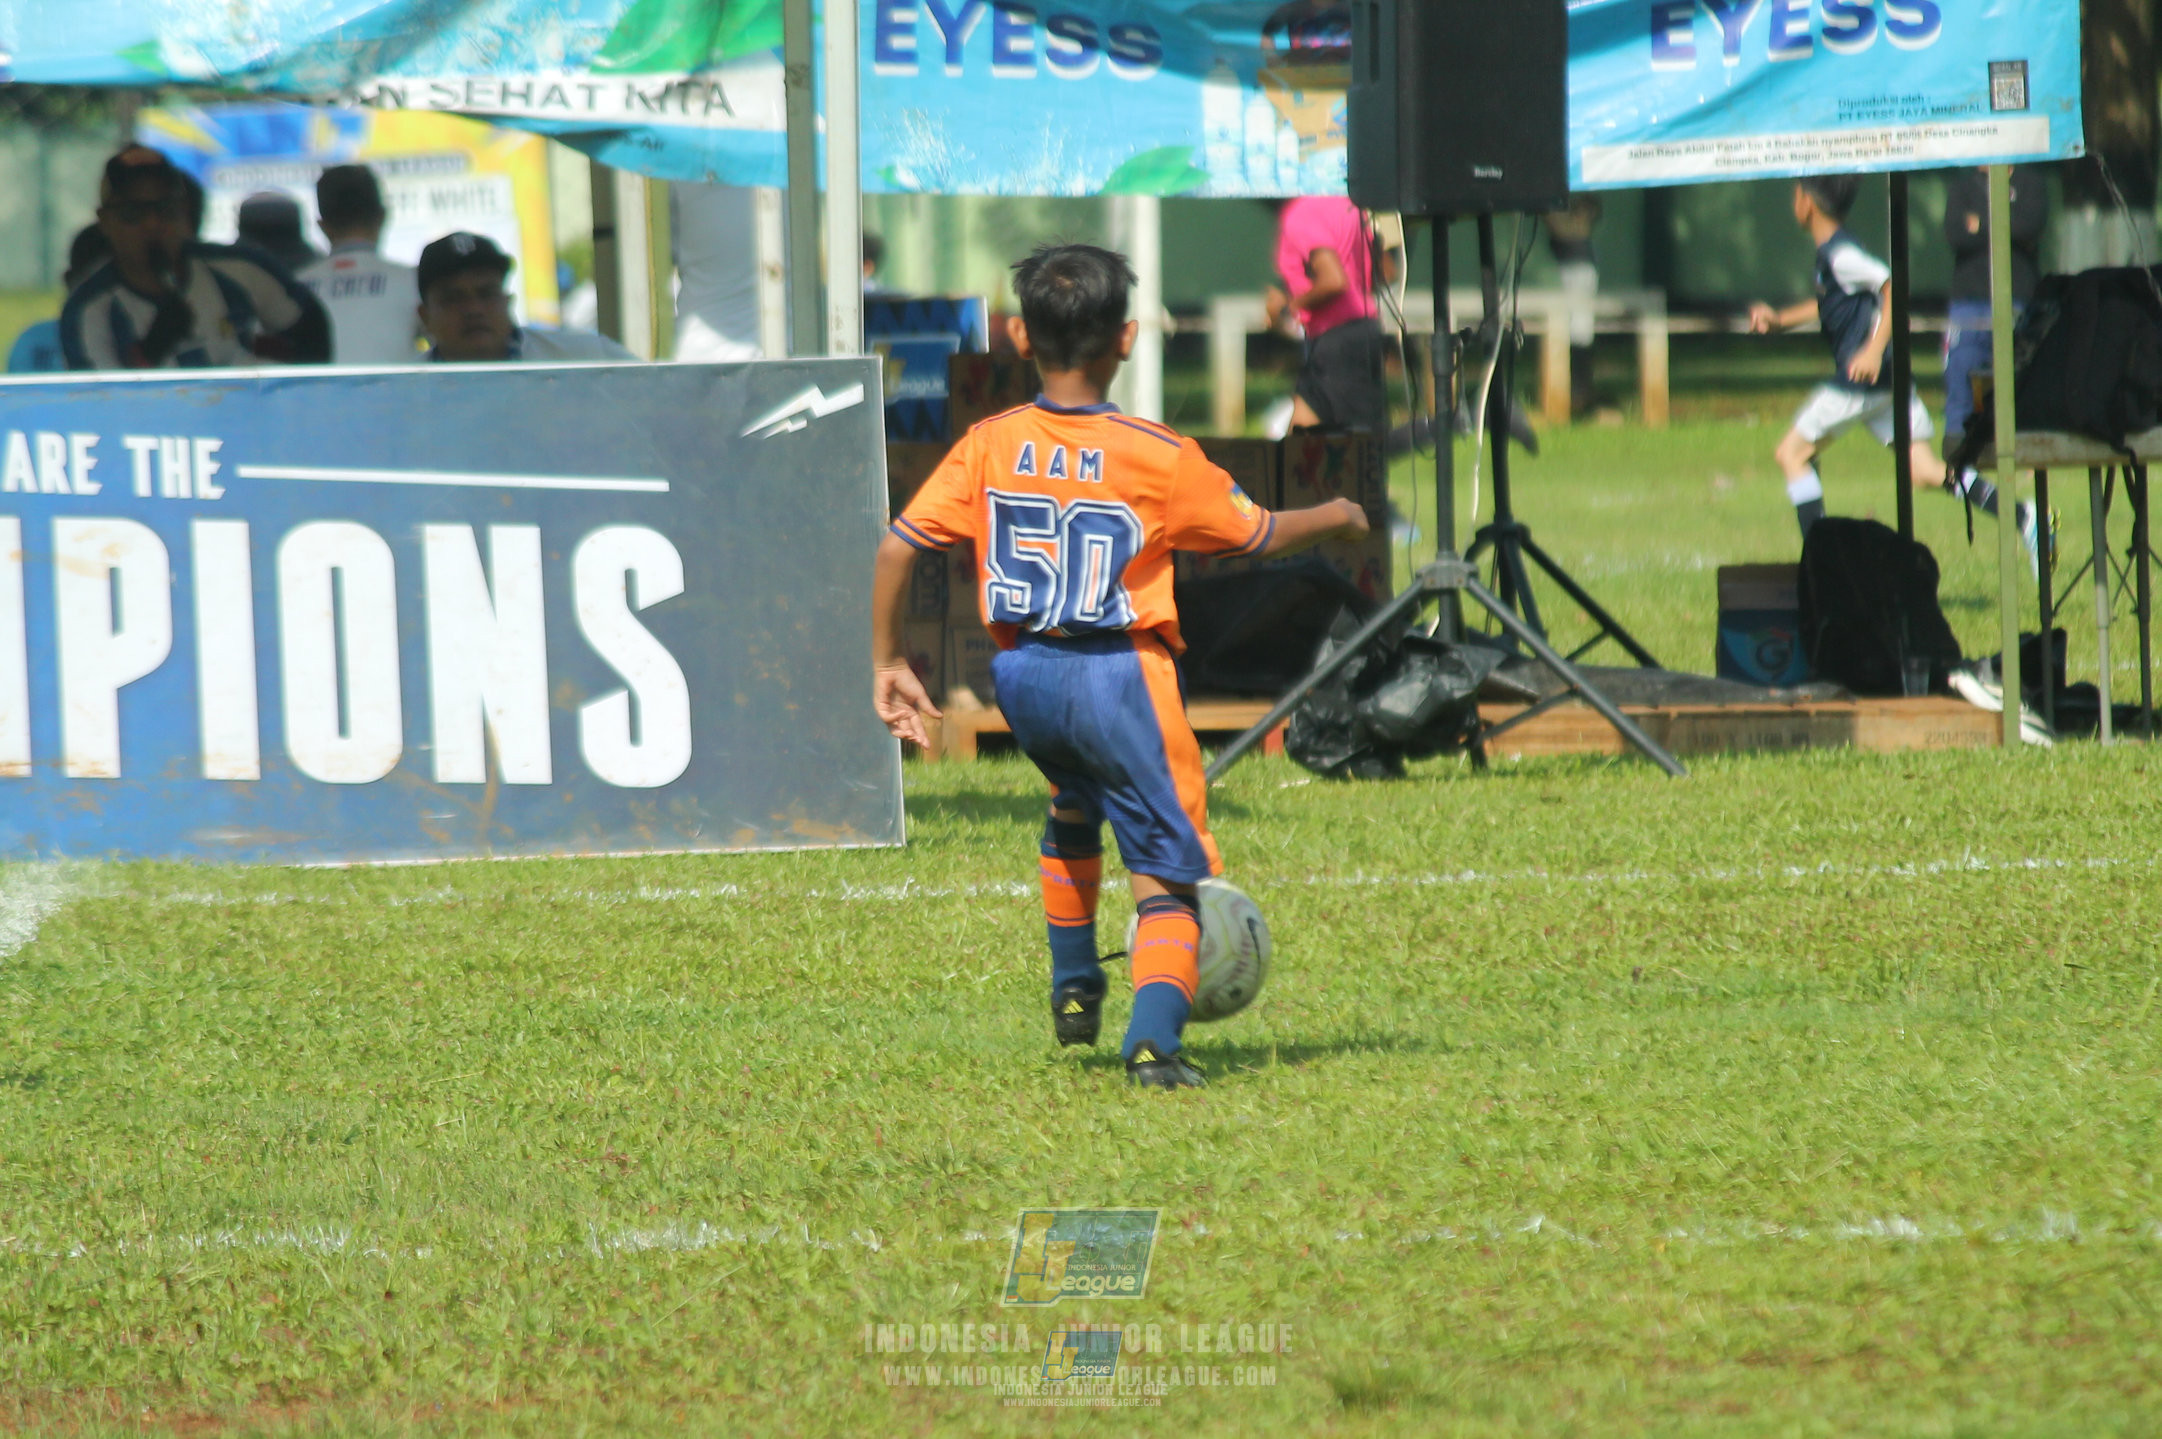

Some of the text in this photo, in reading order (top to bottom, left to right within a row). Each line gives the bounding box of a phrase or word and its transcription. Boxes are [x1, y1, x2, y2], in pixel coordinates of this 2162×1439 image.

[873, 0, 1164, 81] EYESS
[1650, 0, 1942, 71] EYESS
[429, 79, 602, 112] SEHAT
[624, 80, 737, 118] KITA
[1901, 106, 1928, 117] JAYA
[1931, 103, 1980, 115] MINERAL
[3, 431, 225, 500] ARE THE
[1012, 441, 1104, 483] AAM
[985, 487, 1145, 638] 50
[0, 515, 693, 789] PIONS
